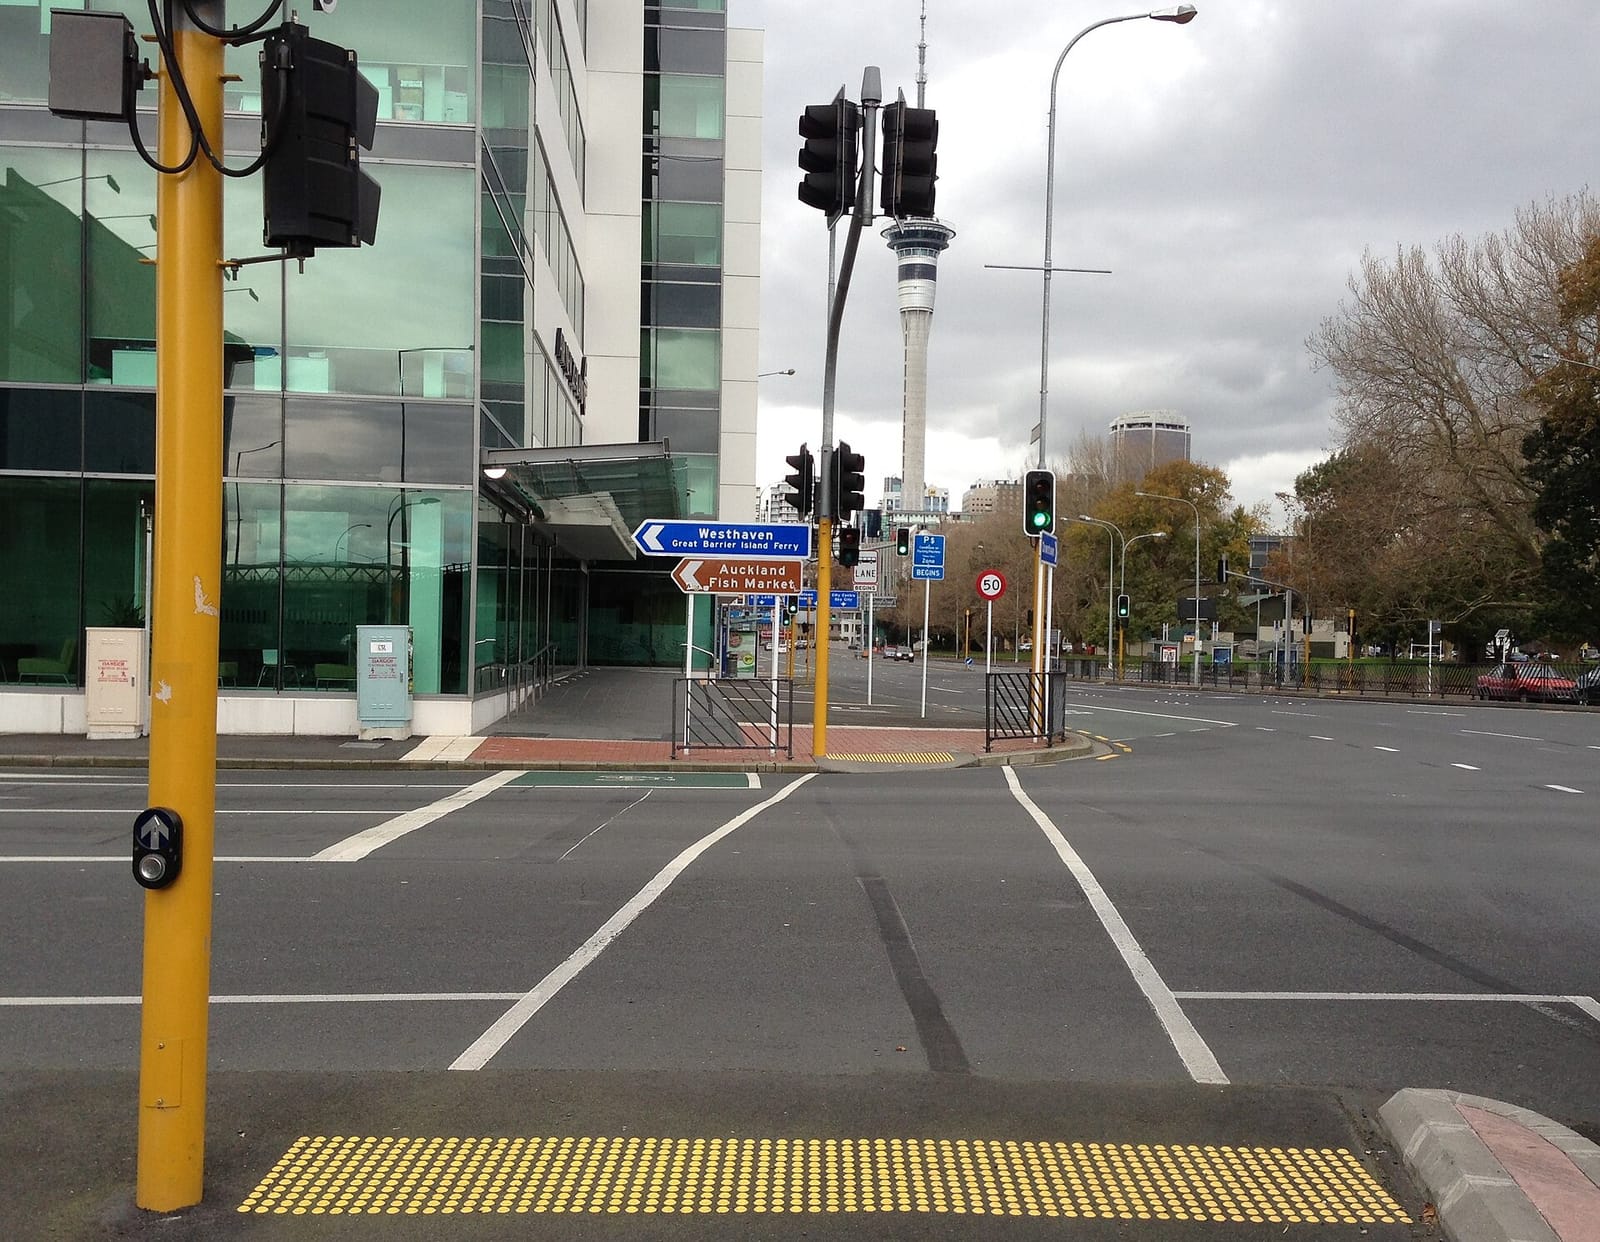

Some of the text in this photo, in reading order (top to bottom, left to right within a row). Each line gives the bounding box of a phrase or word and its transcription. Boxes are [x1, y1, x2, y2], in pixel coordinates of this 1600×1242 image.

[698, 528, 773, 540] Westhaven
[672, 539, 799, 551] Great Barrier Island Ferry
[719, 564, 786, 576] Auckland
[855, 569, 876, 578] LANE
[916, 568, 940, 577] BEGINS
[709, 577, 739, 588] Fish
[744, 578, 795, 590] Market
[983, 579, 1000, 591] 50
